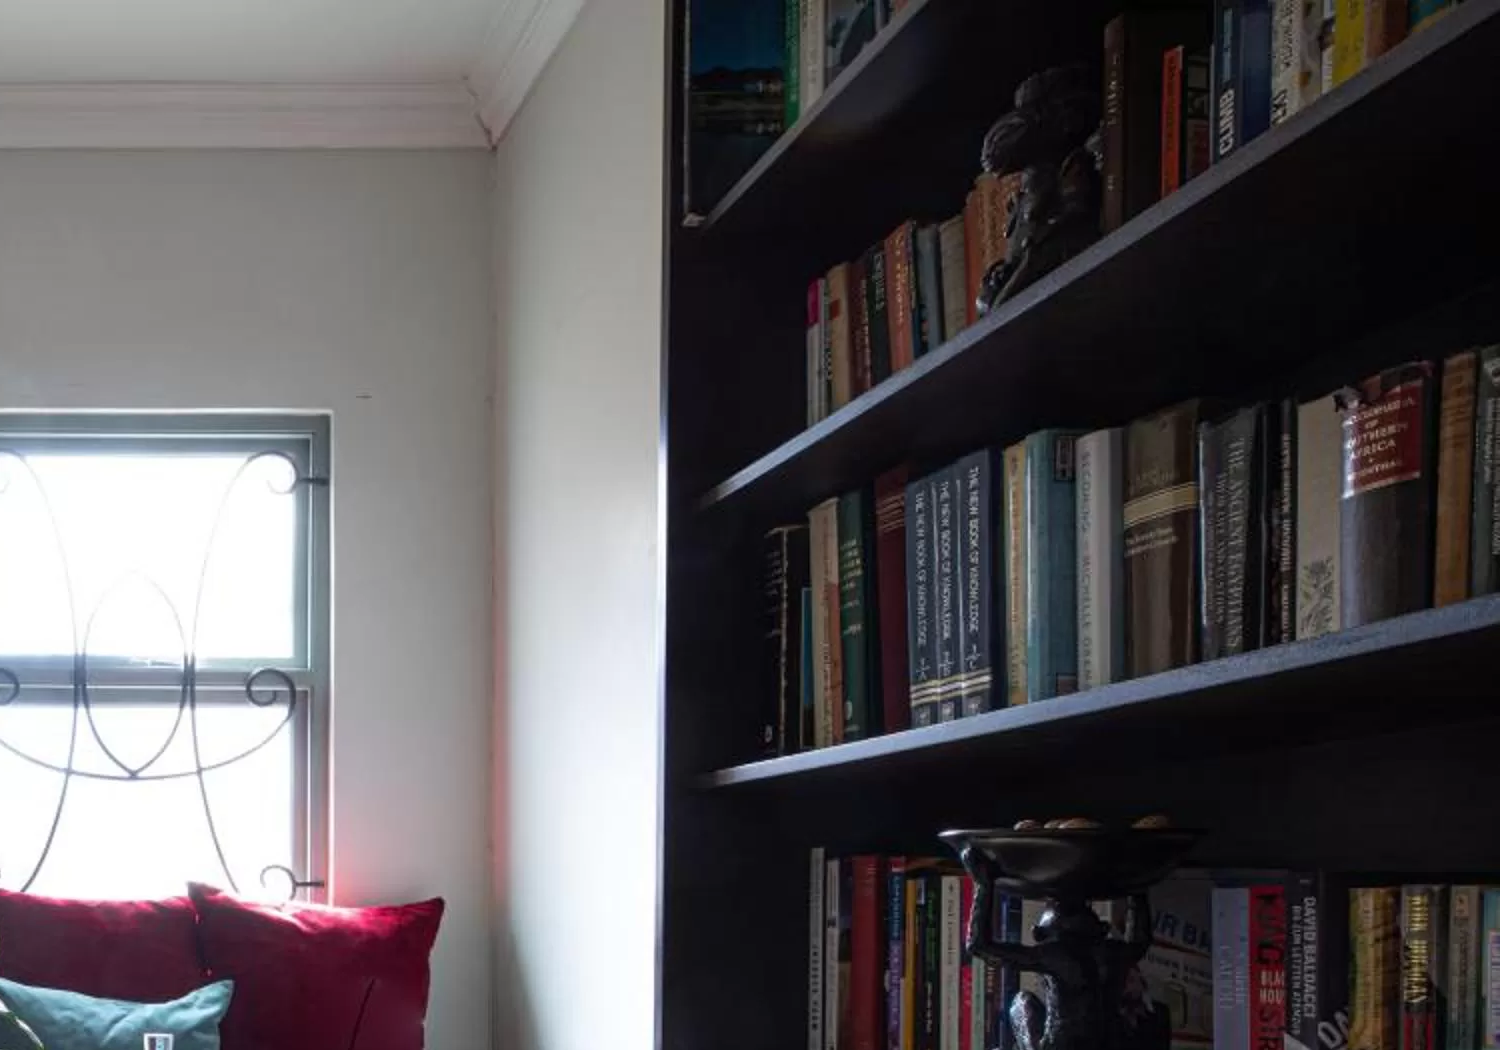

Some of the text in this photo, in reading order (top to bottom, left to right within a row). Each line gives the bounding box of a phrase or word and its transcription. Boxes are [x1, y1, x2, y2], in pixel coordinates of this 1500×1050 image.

[1218, 87, 1235, 156] CLIMB
[1227, 437, 1245, 469] THE
[967, 466, 980, 490] THE
[915, 490, 926, 513] THE
[939, 481, 951, 502] THE
[967, 490, 980, 515] NEW
[1080, 451, 1092, 533] BECOMING
[939, 503, 951, 527] NEW
[1227, 479, 1244, 545] ANCIENT
[915, 514, 926, 538] NEW
[968, 518, 980, 550] BOOK
[915, 540, 926, 568] BOOK
[940, 530, 951, 558] BOOK
[940, 560, 951, 575] OF
[968, 551, 980, 566] OF
[916, 570, 926, 584] OF
[1080, 555, 1092, 629] MICHELLE
[1303, 895, 1317, 1019] DAVID BALDACCI
